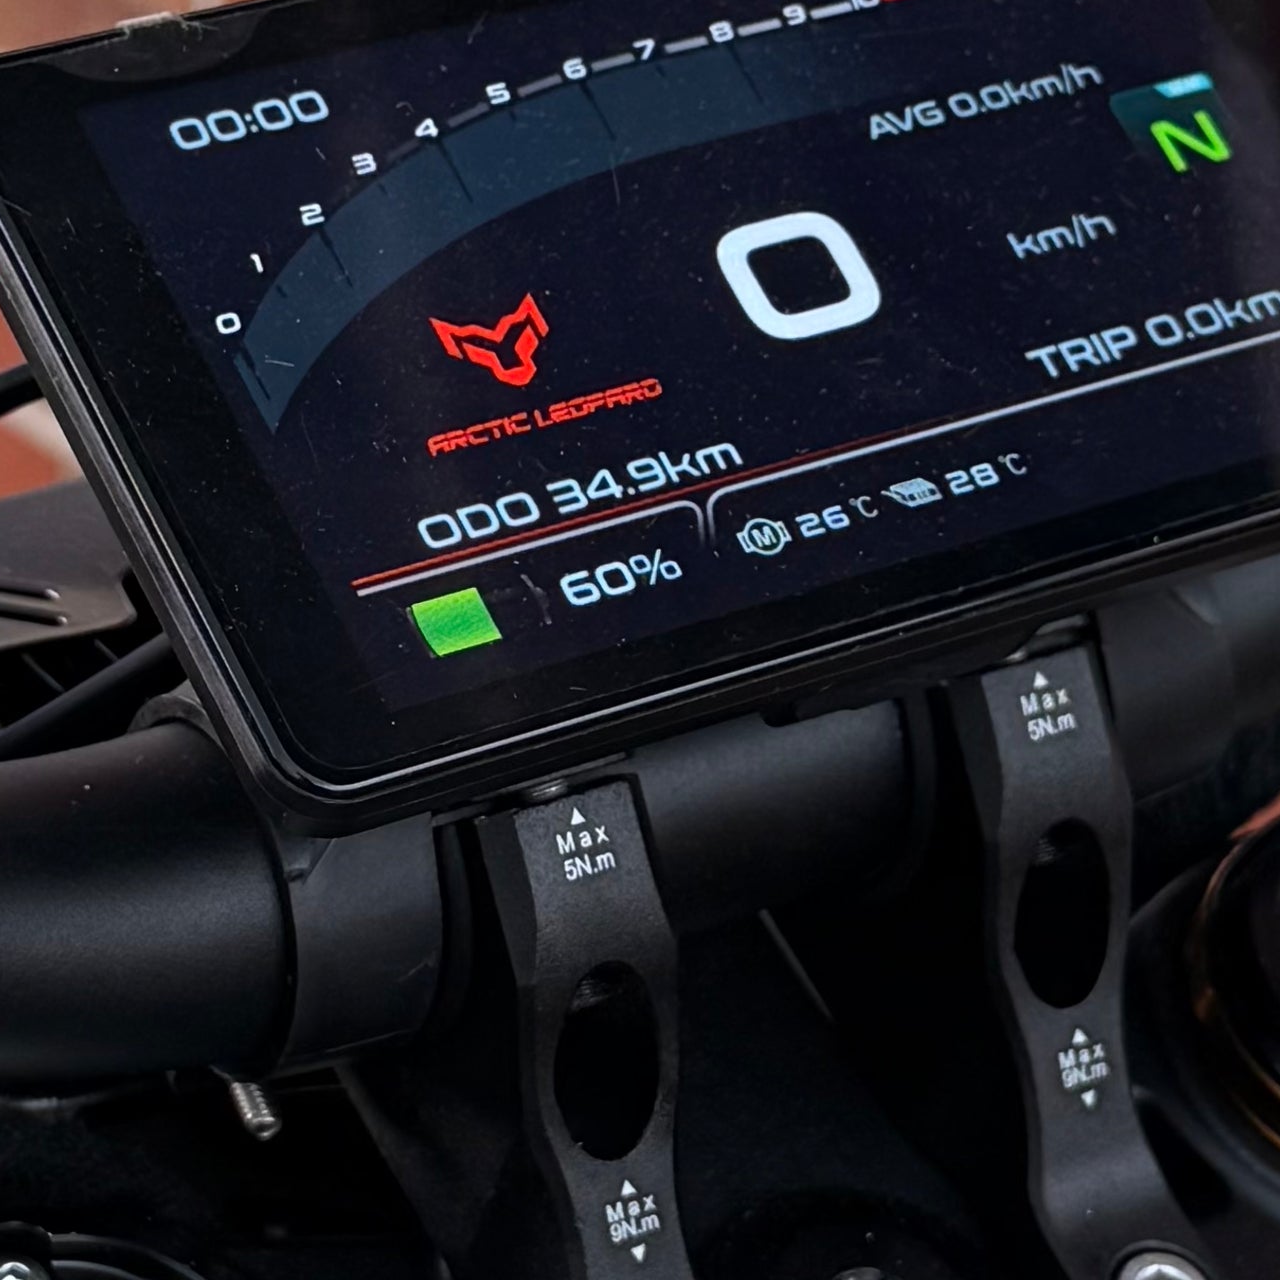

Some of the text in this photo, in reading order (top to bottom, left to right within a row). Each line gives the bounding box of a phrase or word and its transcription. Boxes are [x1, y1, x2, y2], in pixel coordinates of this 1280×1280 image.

[169, 90, 329, 150] 00:00
[870, 100, 946, 140] AVG
[948, 64, 1103, 118] 0.0km/h
[1150, 110, 1231, 172] N
[215, 313, 241, 334] 0
[250, 253, 263, 273] 1
[300, 204, 325, 225] 2
[351, 153, 376, 175] 3
[415, 118, 438, 138] 4
[486, 83, 511, 105] 5
[562, 58, 587, 80] 6
[633, 39, 655, 61] 7
[709, 21, 734, 43] 8
[782, 5, 807, 26] 9
[1006, 214, 1116, 259] km/h
[717, 212, 881, 340] 0
[1024, 325, 1137, 378] TRIP
[427, 378, 663, 457] ARCTIC LEOPARD
[418, 442, 743, 549] ODO 34.9km
[945, 462, 1000, 495] 28
[752, 526, 777, 547] M
[795, 505, 850, 538] 26
[560, 549, 682, 606] 60%
[1020, 688, 1070, 716] Max
[1027, 713, 1076, 741] 5N.m
[556, 825, 610, 855] Max
[564, 851, 616, 881] 5N.m
[1058, 1043, 1105, 1070] Max
[605, 1194, 657, 1222] Max
[609, 1214, 660, 1243] 9N.m
